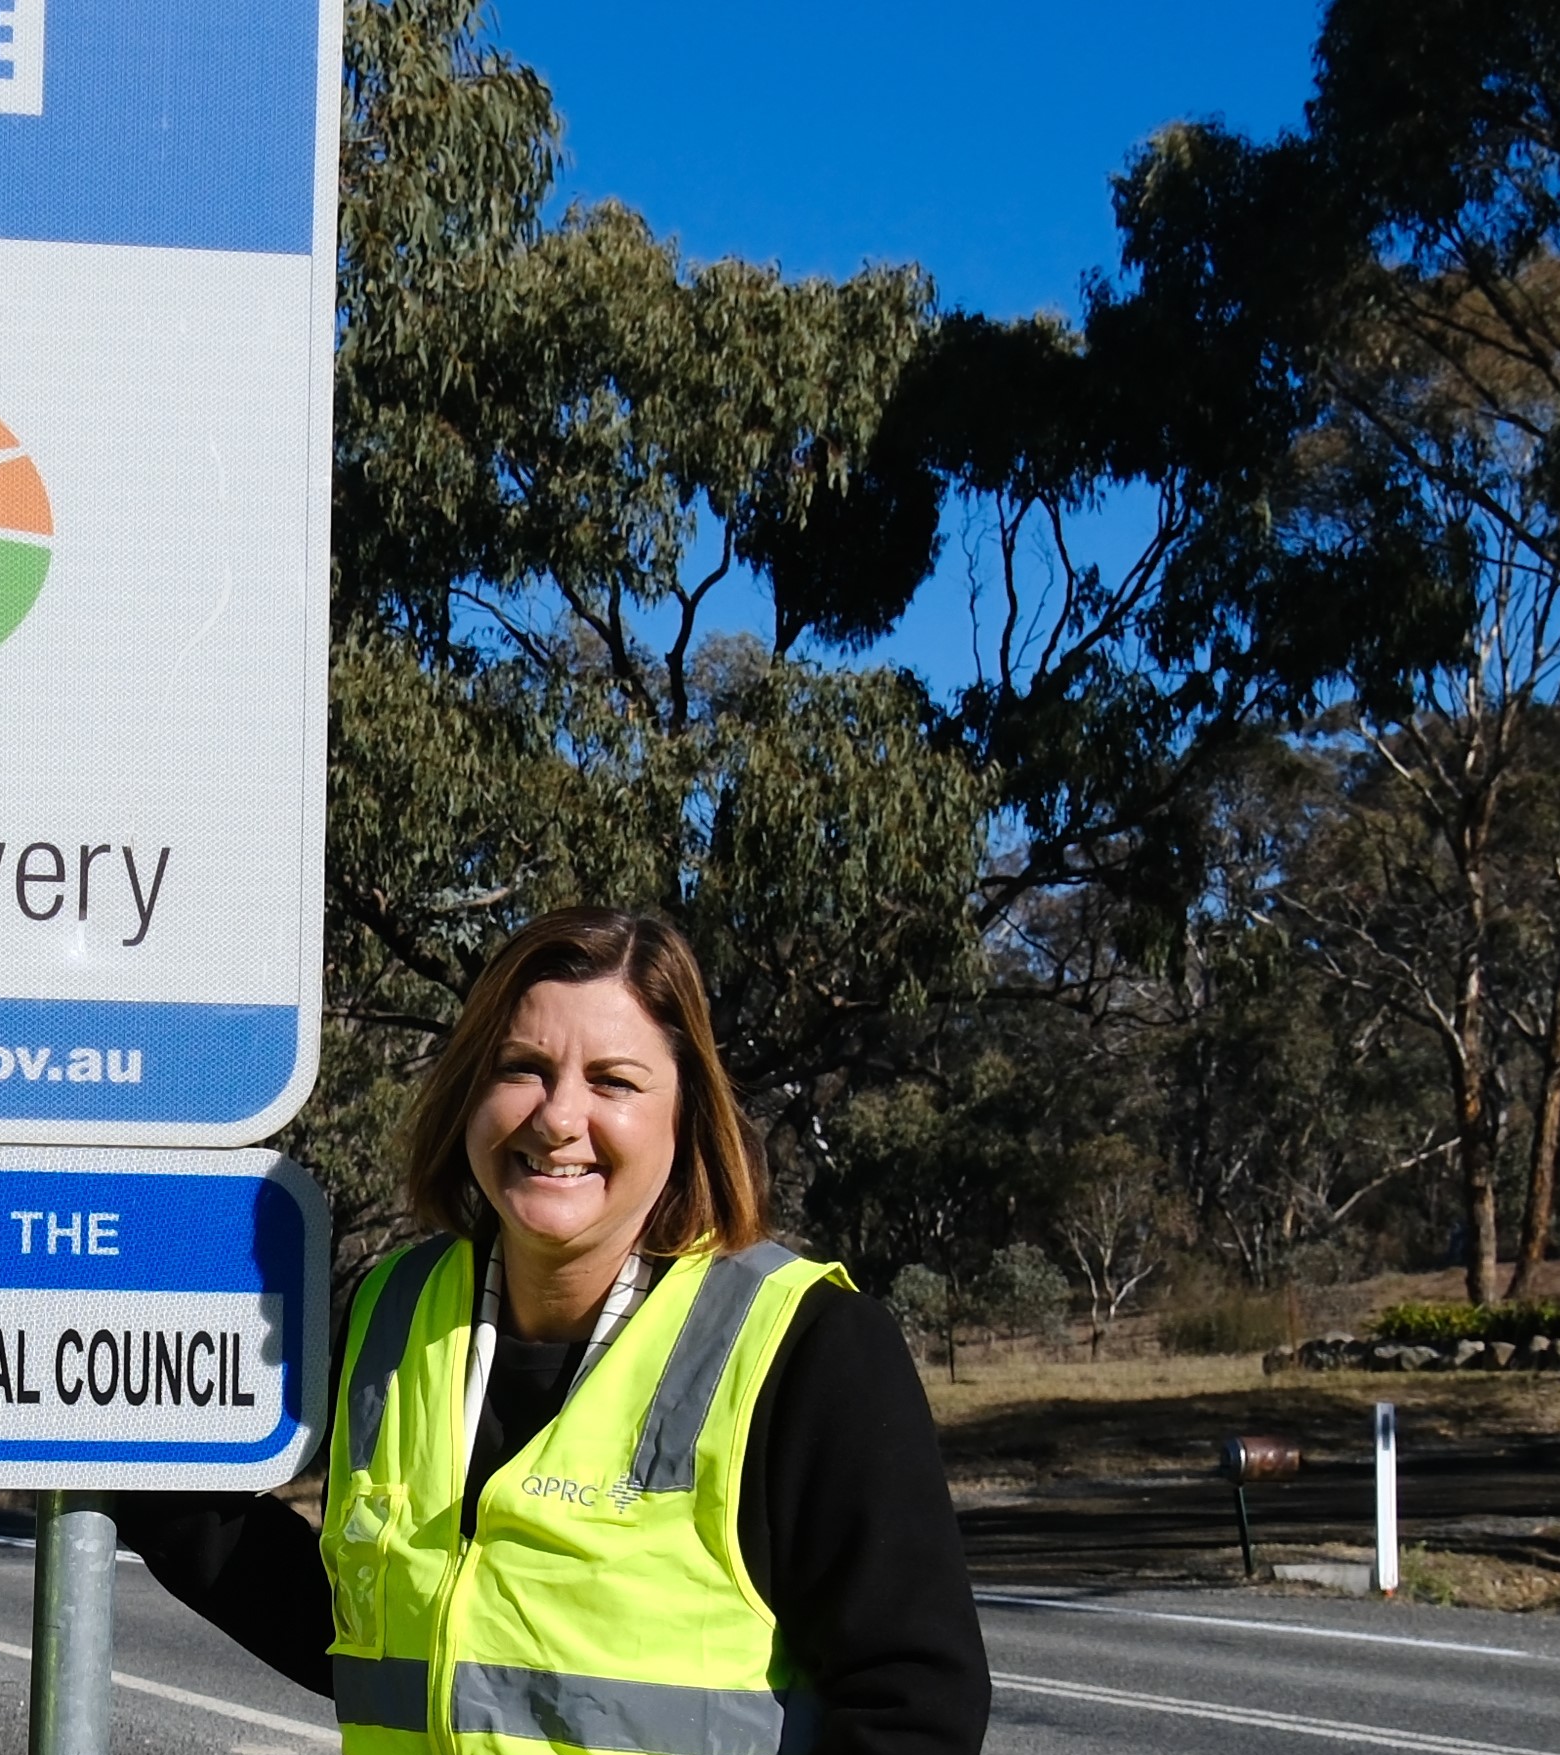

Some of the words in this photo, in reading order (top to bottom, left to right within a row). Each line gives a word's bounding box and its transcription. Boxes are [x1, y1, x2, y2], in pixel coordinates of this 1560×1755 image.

[10, 1210, 120, 1256] THE
[54, 1328, 255, 1408] COUNCIL
[521, 1474, 599, 1507] QPRC
